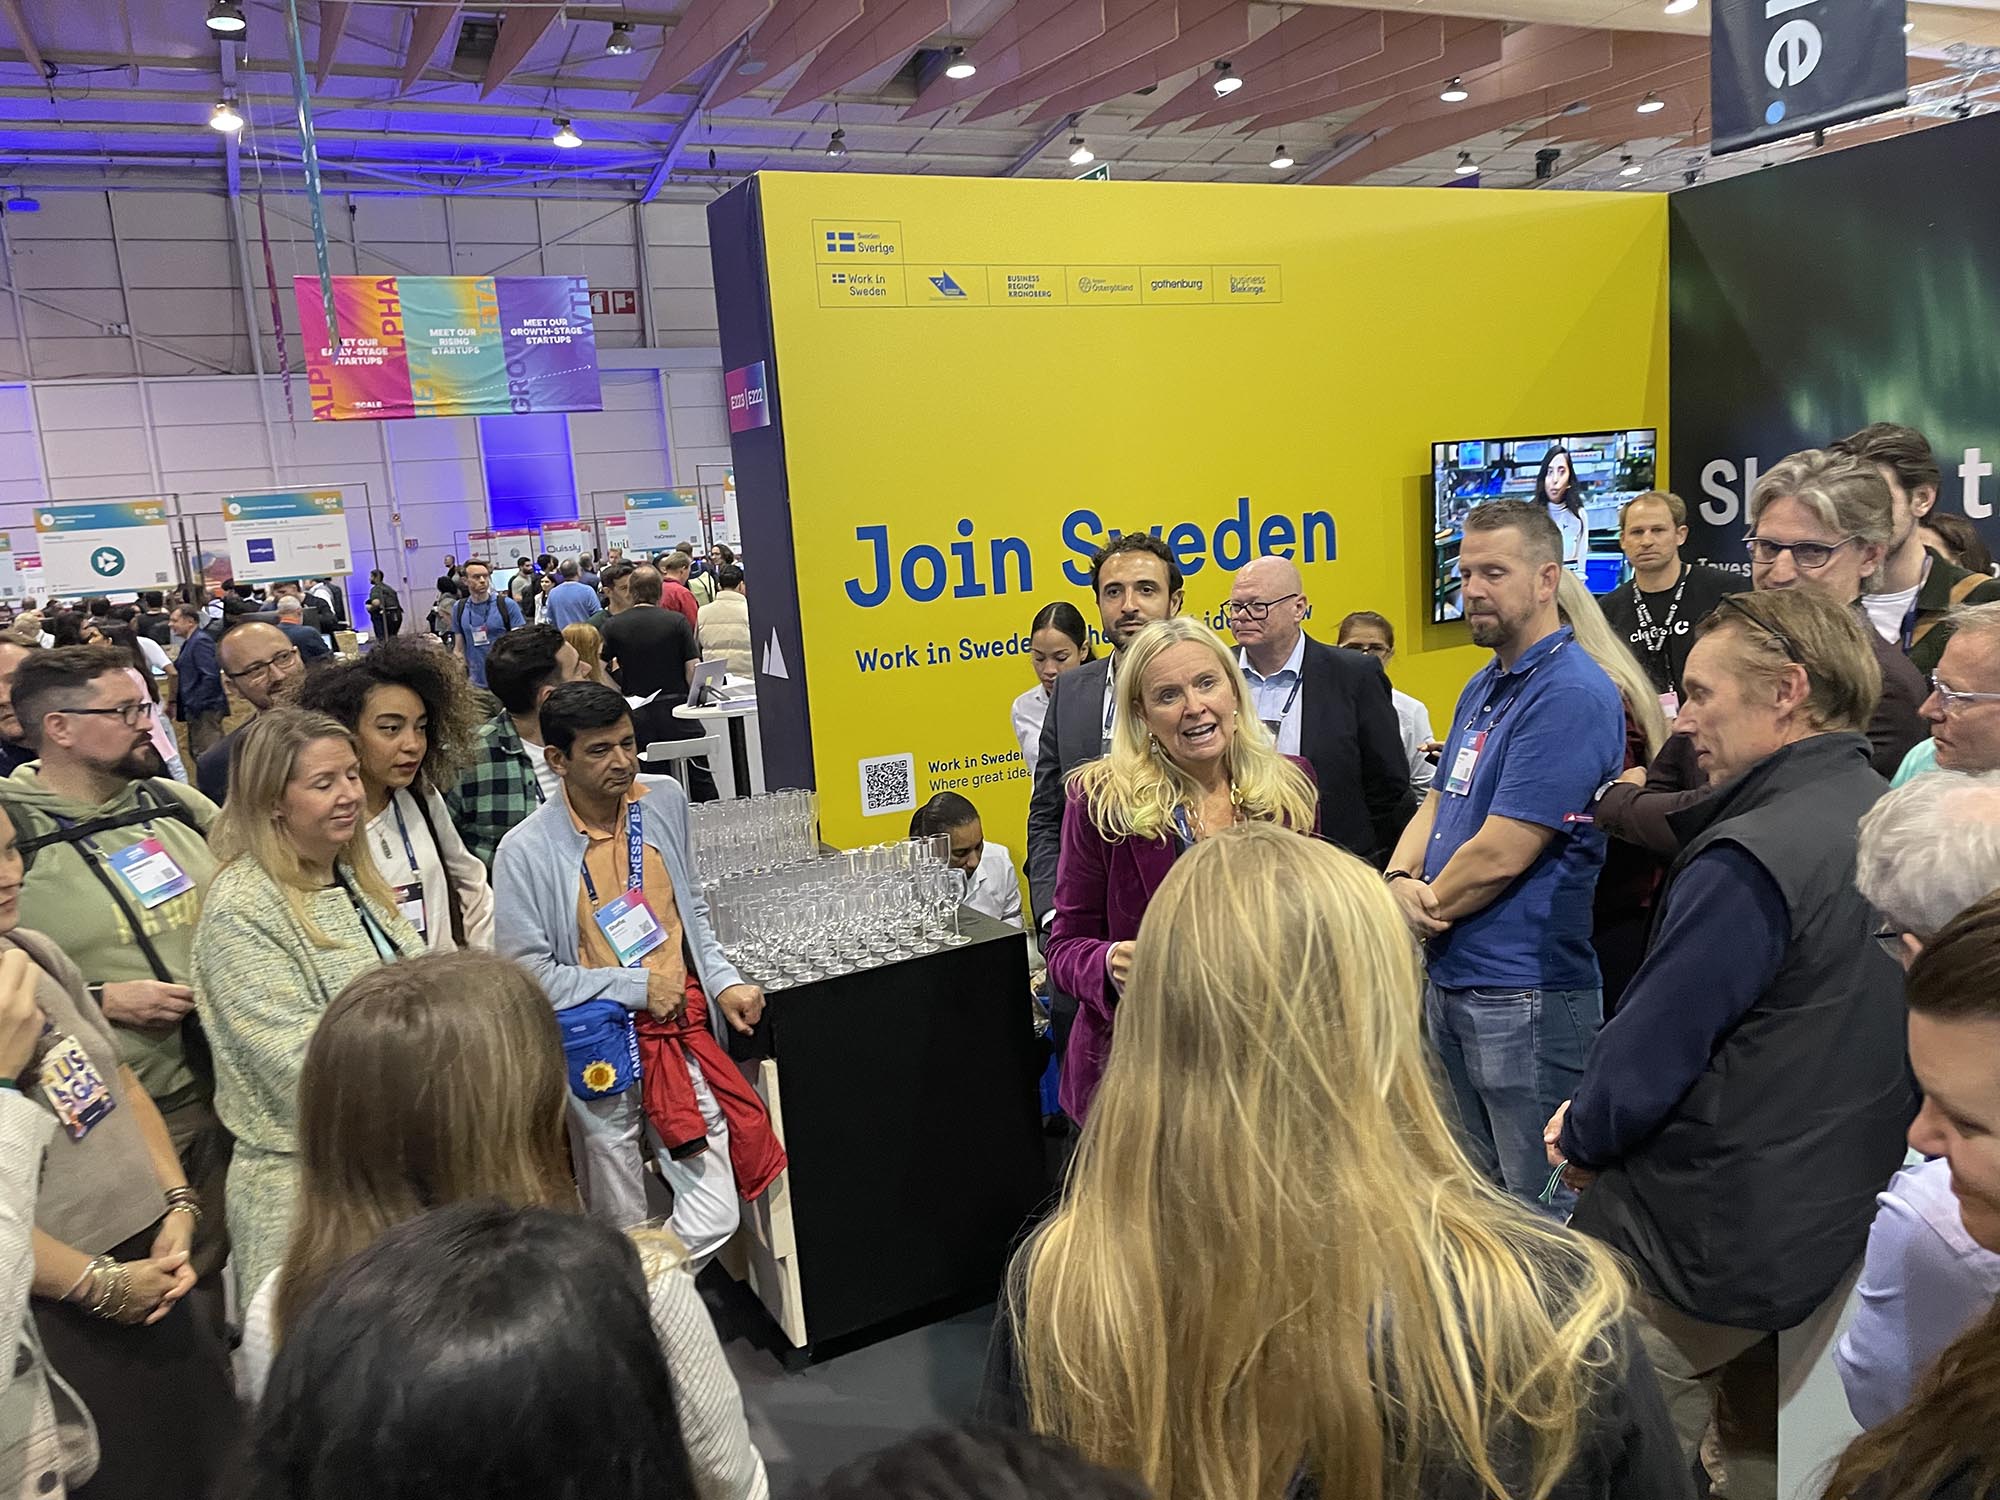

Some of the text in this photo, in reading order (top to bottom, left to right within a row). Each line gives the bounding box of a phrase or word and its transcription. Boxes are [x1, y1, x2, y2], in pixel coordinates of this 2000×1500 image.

[858, 242, 895, 255] Sverige
[848, 273, 886, 284] Work in
[1150, 279, 1203, 291] gothenburg
[850, 286, 886, 296] Sweden
[1008, 290, 1052, 298] KRONOBERG
[523, 318, 568, 327] MEET OUR
[429, 328, 476, 337] MEET OUR
[510, 326, 584, 336] GROWTH-STAGE
[358, 338, 379, 347] OUR
[438, 337, 470, 346] RISING
[525, 336, 572, 345] STARTUPS
[321, 347, 389, 357] EALY-STAGE
[431, 346, 480, 355] STARTUPS
[844, 497, 1337, 608] Join Seden
[855, 633, 1032, 673] Work in Swede
[928, 758, 961, 774] Work
[964, 756, 978, 768] in
[929, 766, 1032, 792] Where great idea
